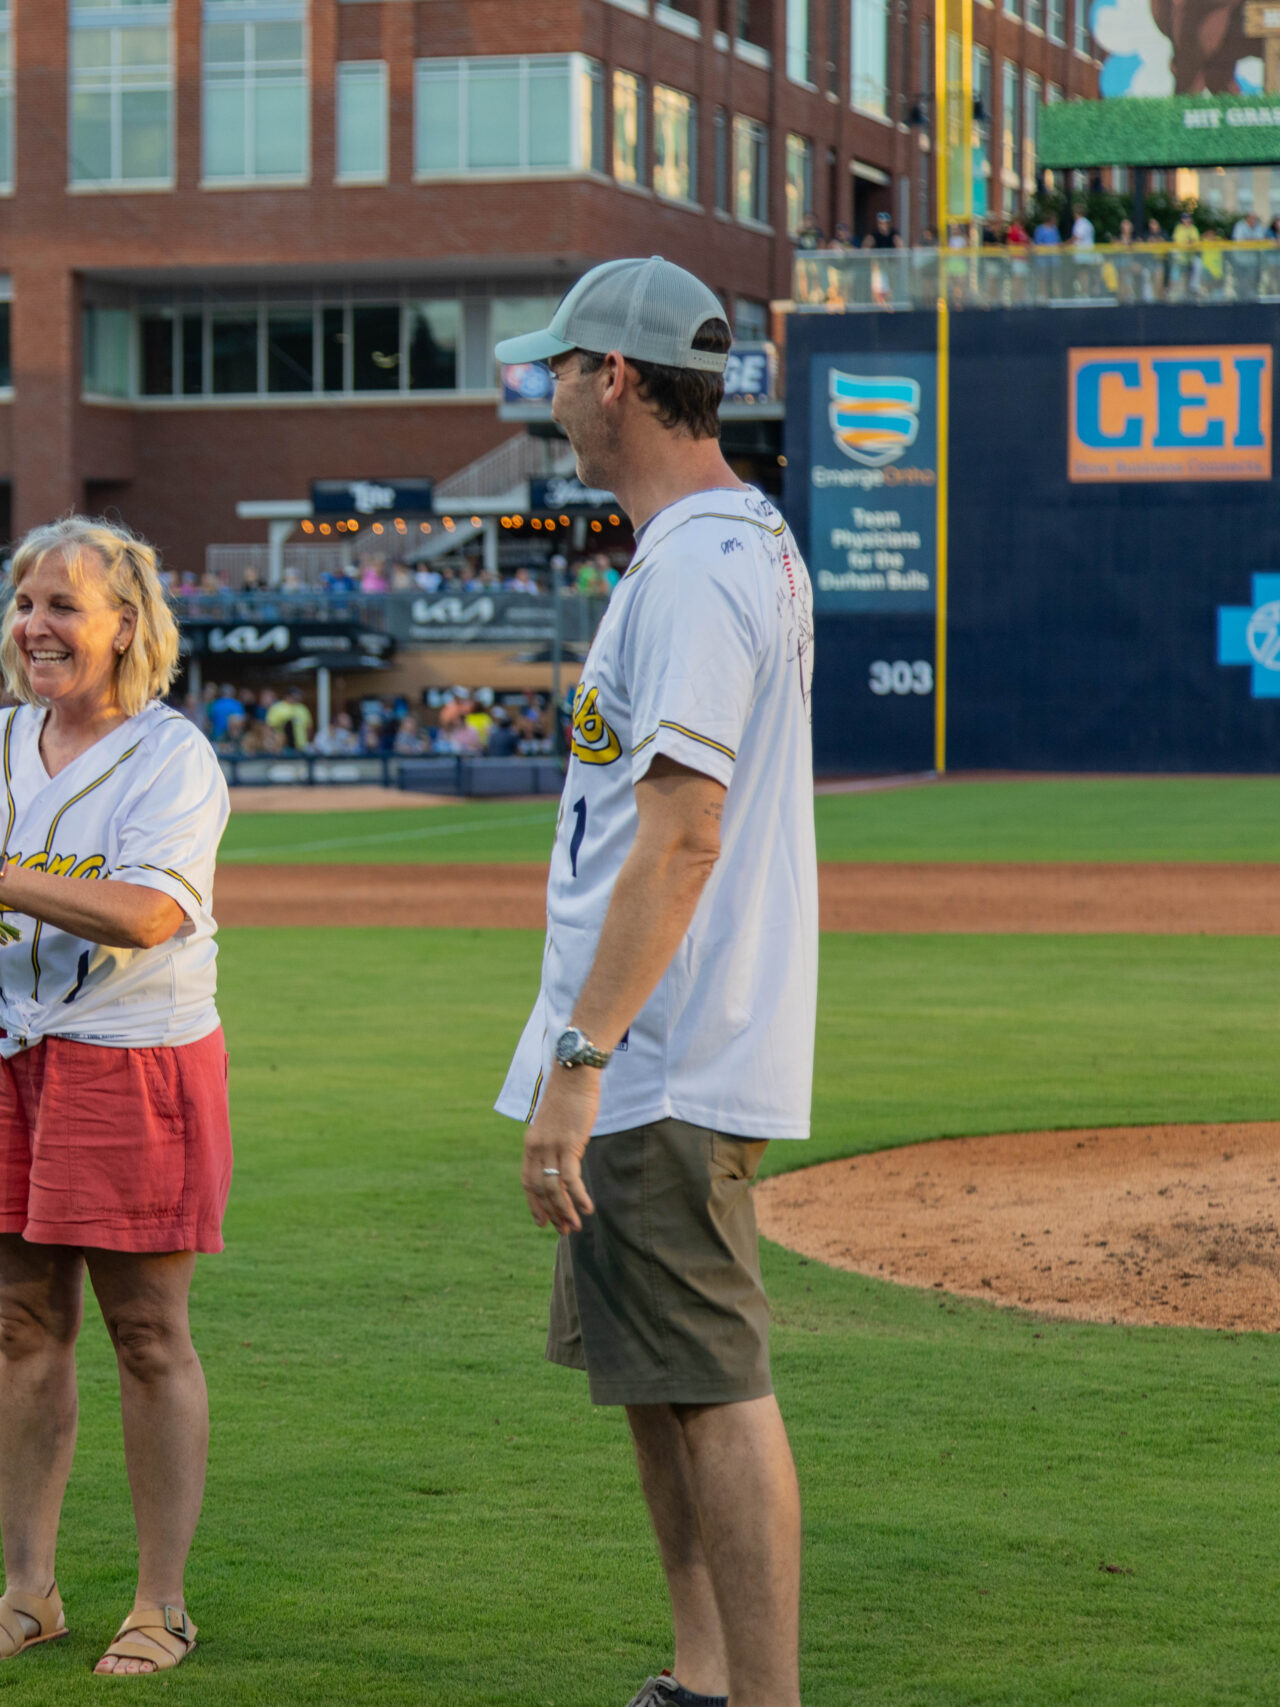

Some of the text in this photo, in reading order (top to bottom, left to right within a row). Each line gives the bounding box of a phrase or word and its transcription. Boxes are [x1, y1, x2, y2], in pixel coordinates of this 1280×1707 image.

[1076, 359, 1266, 449] CEI
[851, 507, 901, 529] Team
[831, 529, 921, 551] Physicians
[847, 550, 904, 570] for the
[818, 570, 929, 591] Durham Bulls
[869, 660, 933, 695] 303
